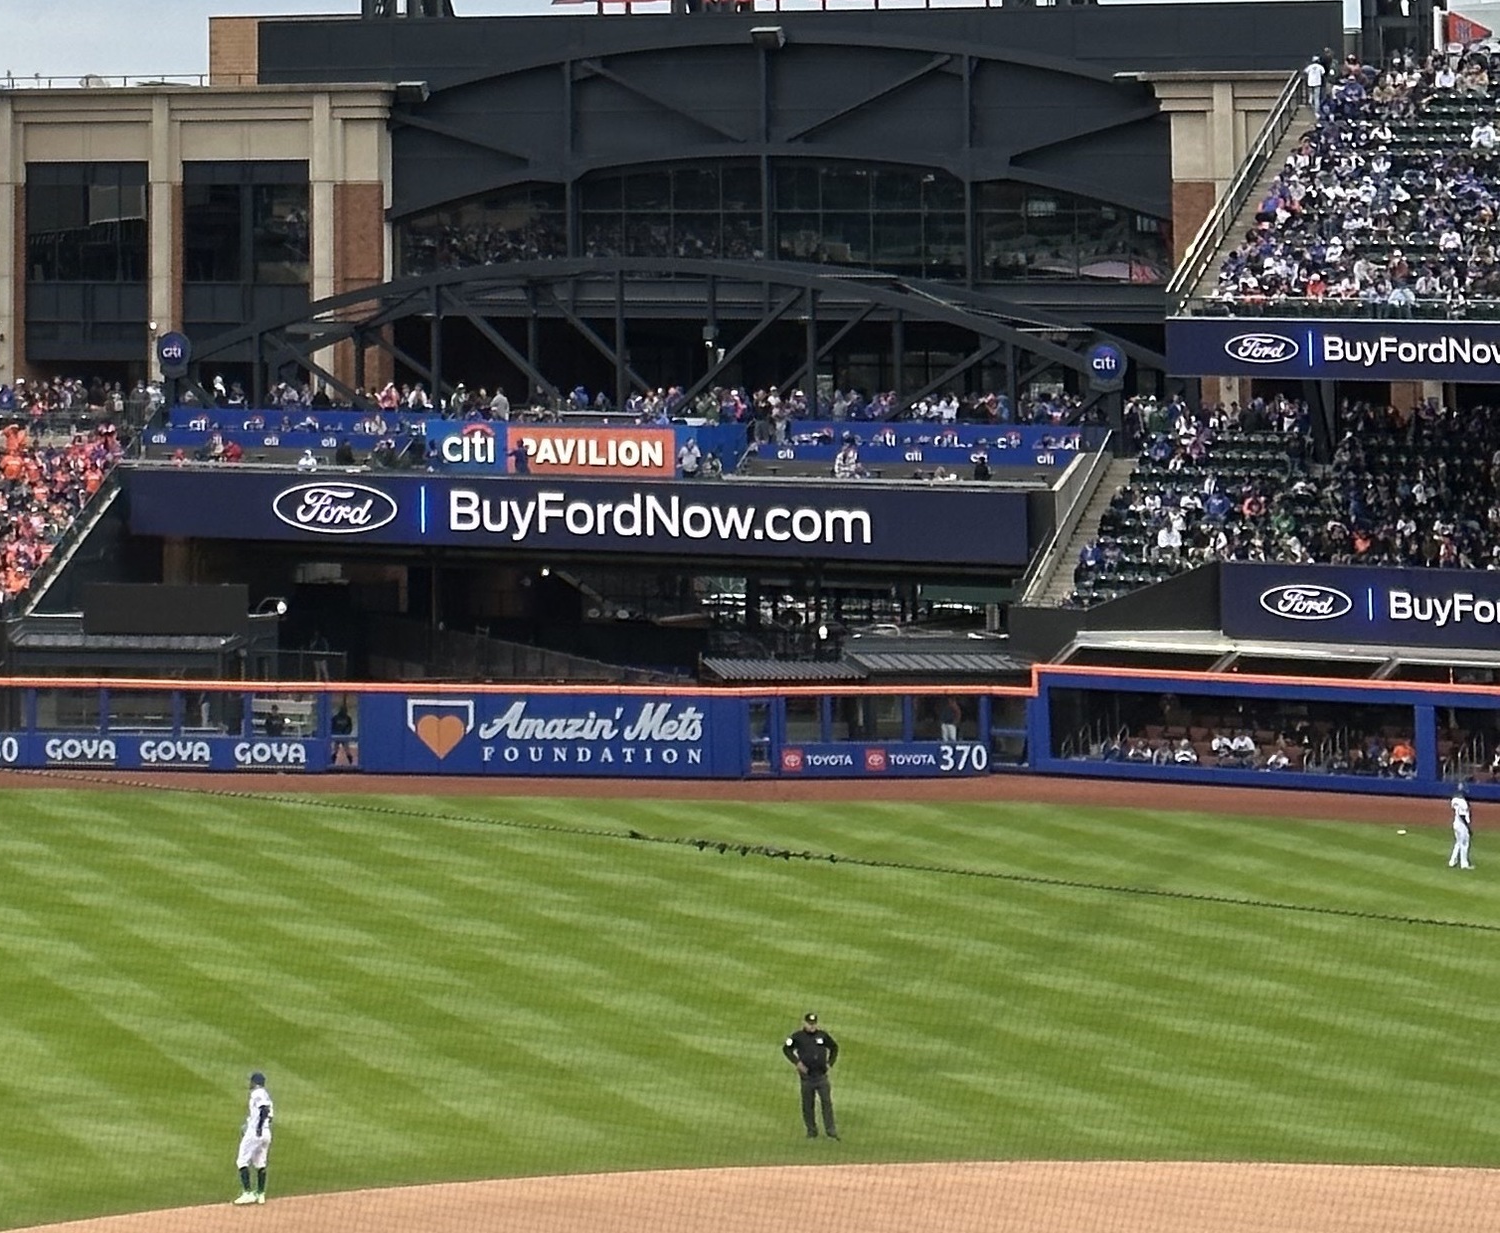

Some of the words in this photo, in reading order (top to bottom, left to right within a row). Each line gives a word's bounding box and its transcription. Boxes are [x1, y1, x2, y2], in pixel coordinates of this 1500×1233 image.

[1237, 336, 1285, 360] Ford
[442, 427, 495, 464] citi
[523, 437, 663, 467] PAVILION
[296, 488, 375, 526] Ford
[449, 488, 872, 546] BuyFordNow.com
[1277, 589, 1334, 615] Ford
[479, 701, 623, 742] Amazin'
[624, 700, 703, 742] Mets
[45, 738, 116, 761] GOYA
[140, 740, 211, 762] GOYA
[234, 741, 306, 765] GOYA
[483, 746, 703, 764] FOUNDATION
[805, 753, 854, 767] TOYOTA
[889, 753, 937, 767] TOYOTA
[939, 745, 987, 771] 370
